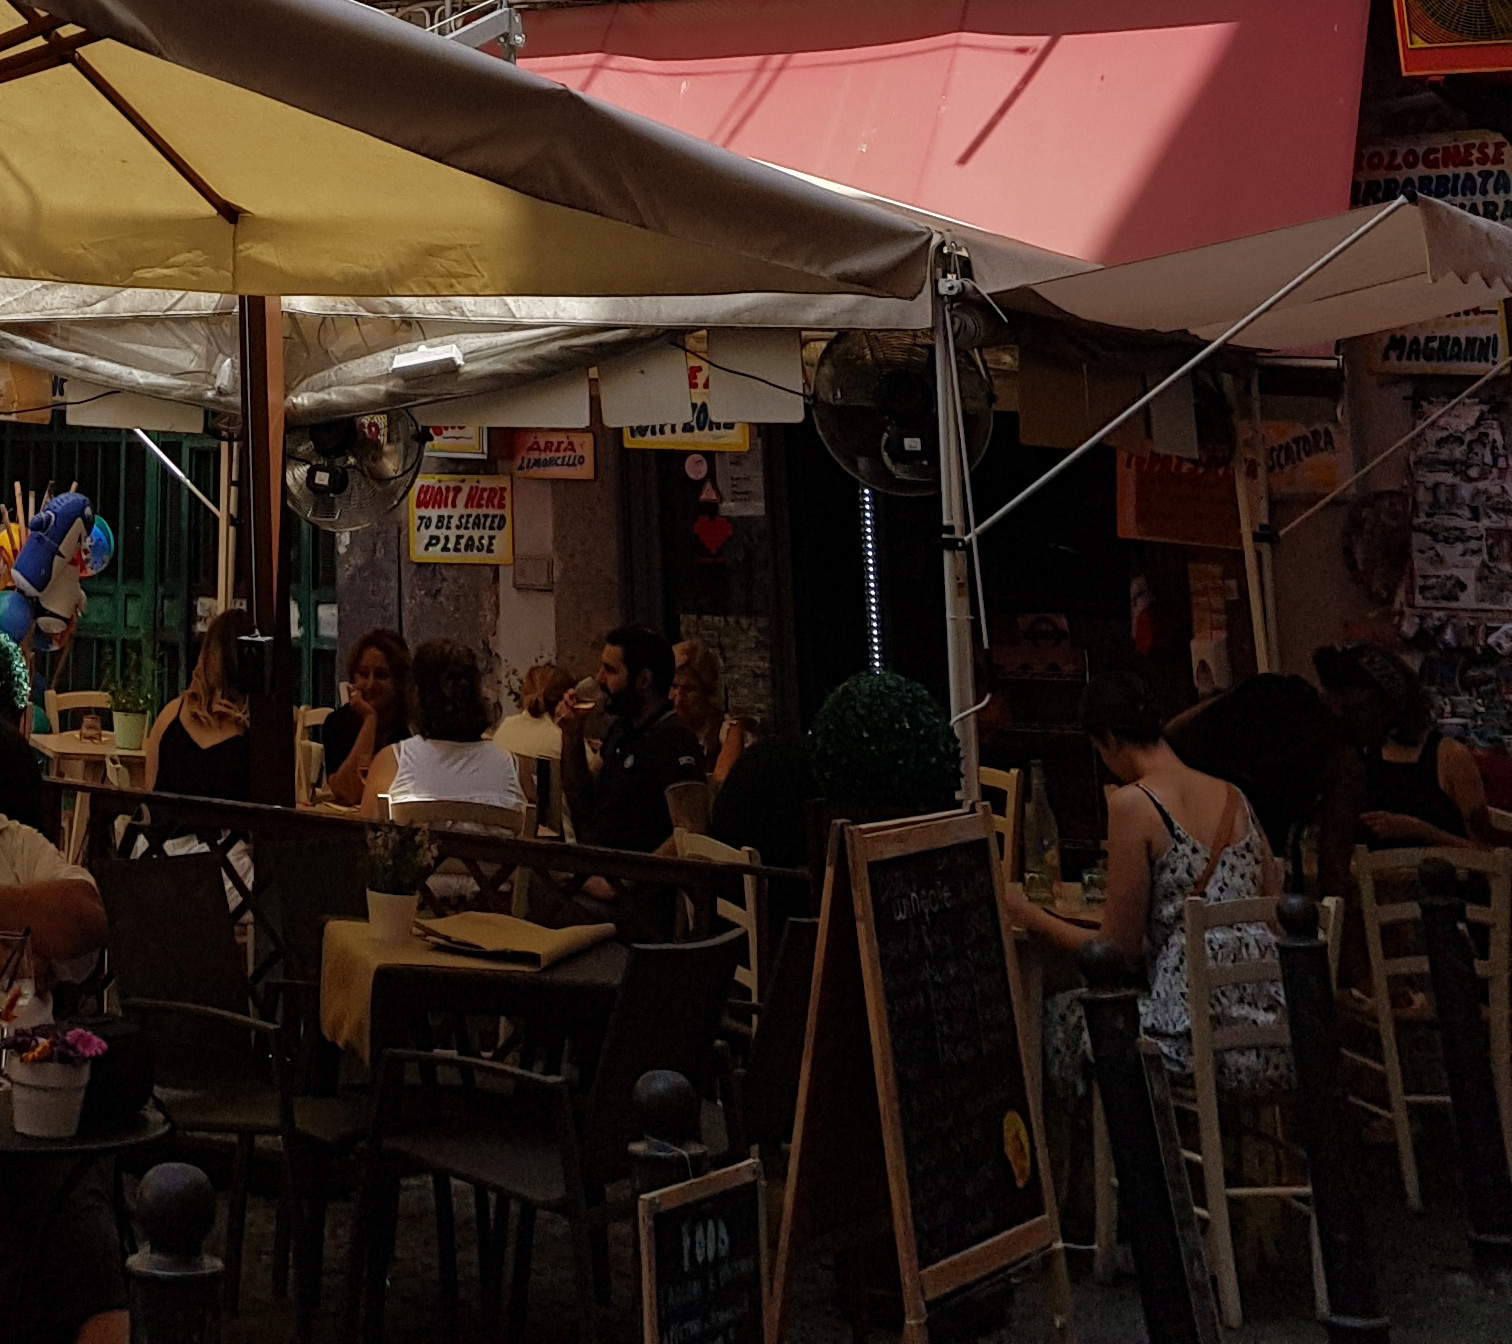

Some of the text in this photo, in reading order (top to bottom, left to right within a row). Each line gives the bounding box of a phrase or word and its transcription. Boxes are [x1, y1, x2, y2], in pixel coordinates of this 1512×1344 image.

[415, 484, 507, 509] WAIT HERE
[416, 514, 507, 531] TO BE SEATED
[424, 534, 496, 554] PLEASE
